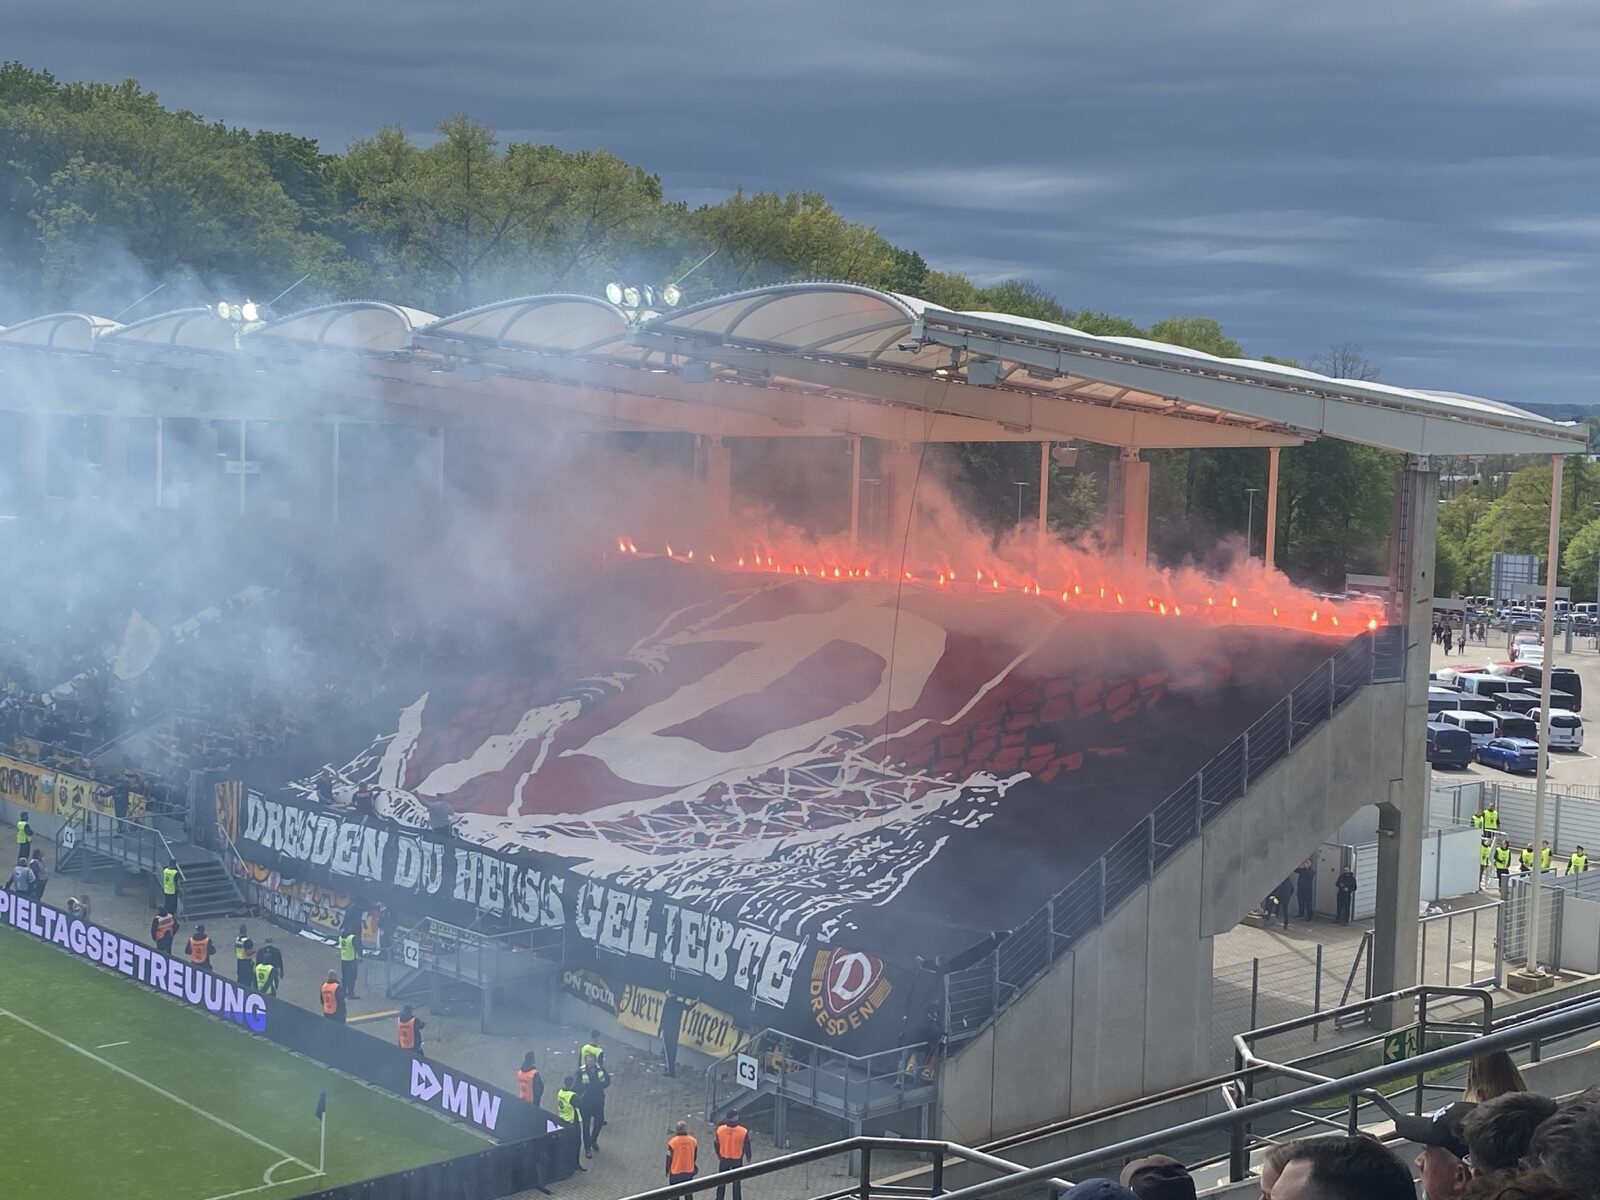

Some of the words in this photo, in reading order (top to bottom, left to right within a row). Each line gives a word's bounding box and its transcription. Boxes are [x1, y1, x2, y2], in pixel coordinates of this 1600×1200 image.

[244, 791, 389, 882] DRESDEN
[394, 831, 444, 895] DU
[453, 847, 566, 929] HEISS
[575, 878, 810, 1010] GELIEBTE
[0, 889, 267, 1034] PIELTAGSBETREUUNG
[563, 970, 582, 991] ON
[808, 979, 875, 1037] DRESDEN
[739, 1060, 756, 1082] C3
